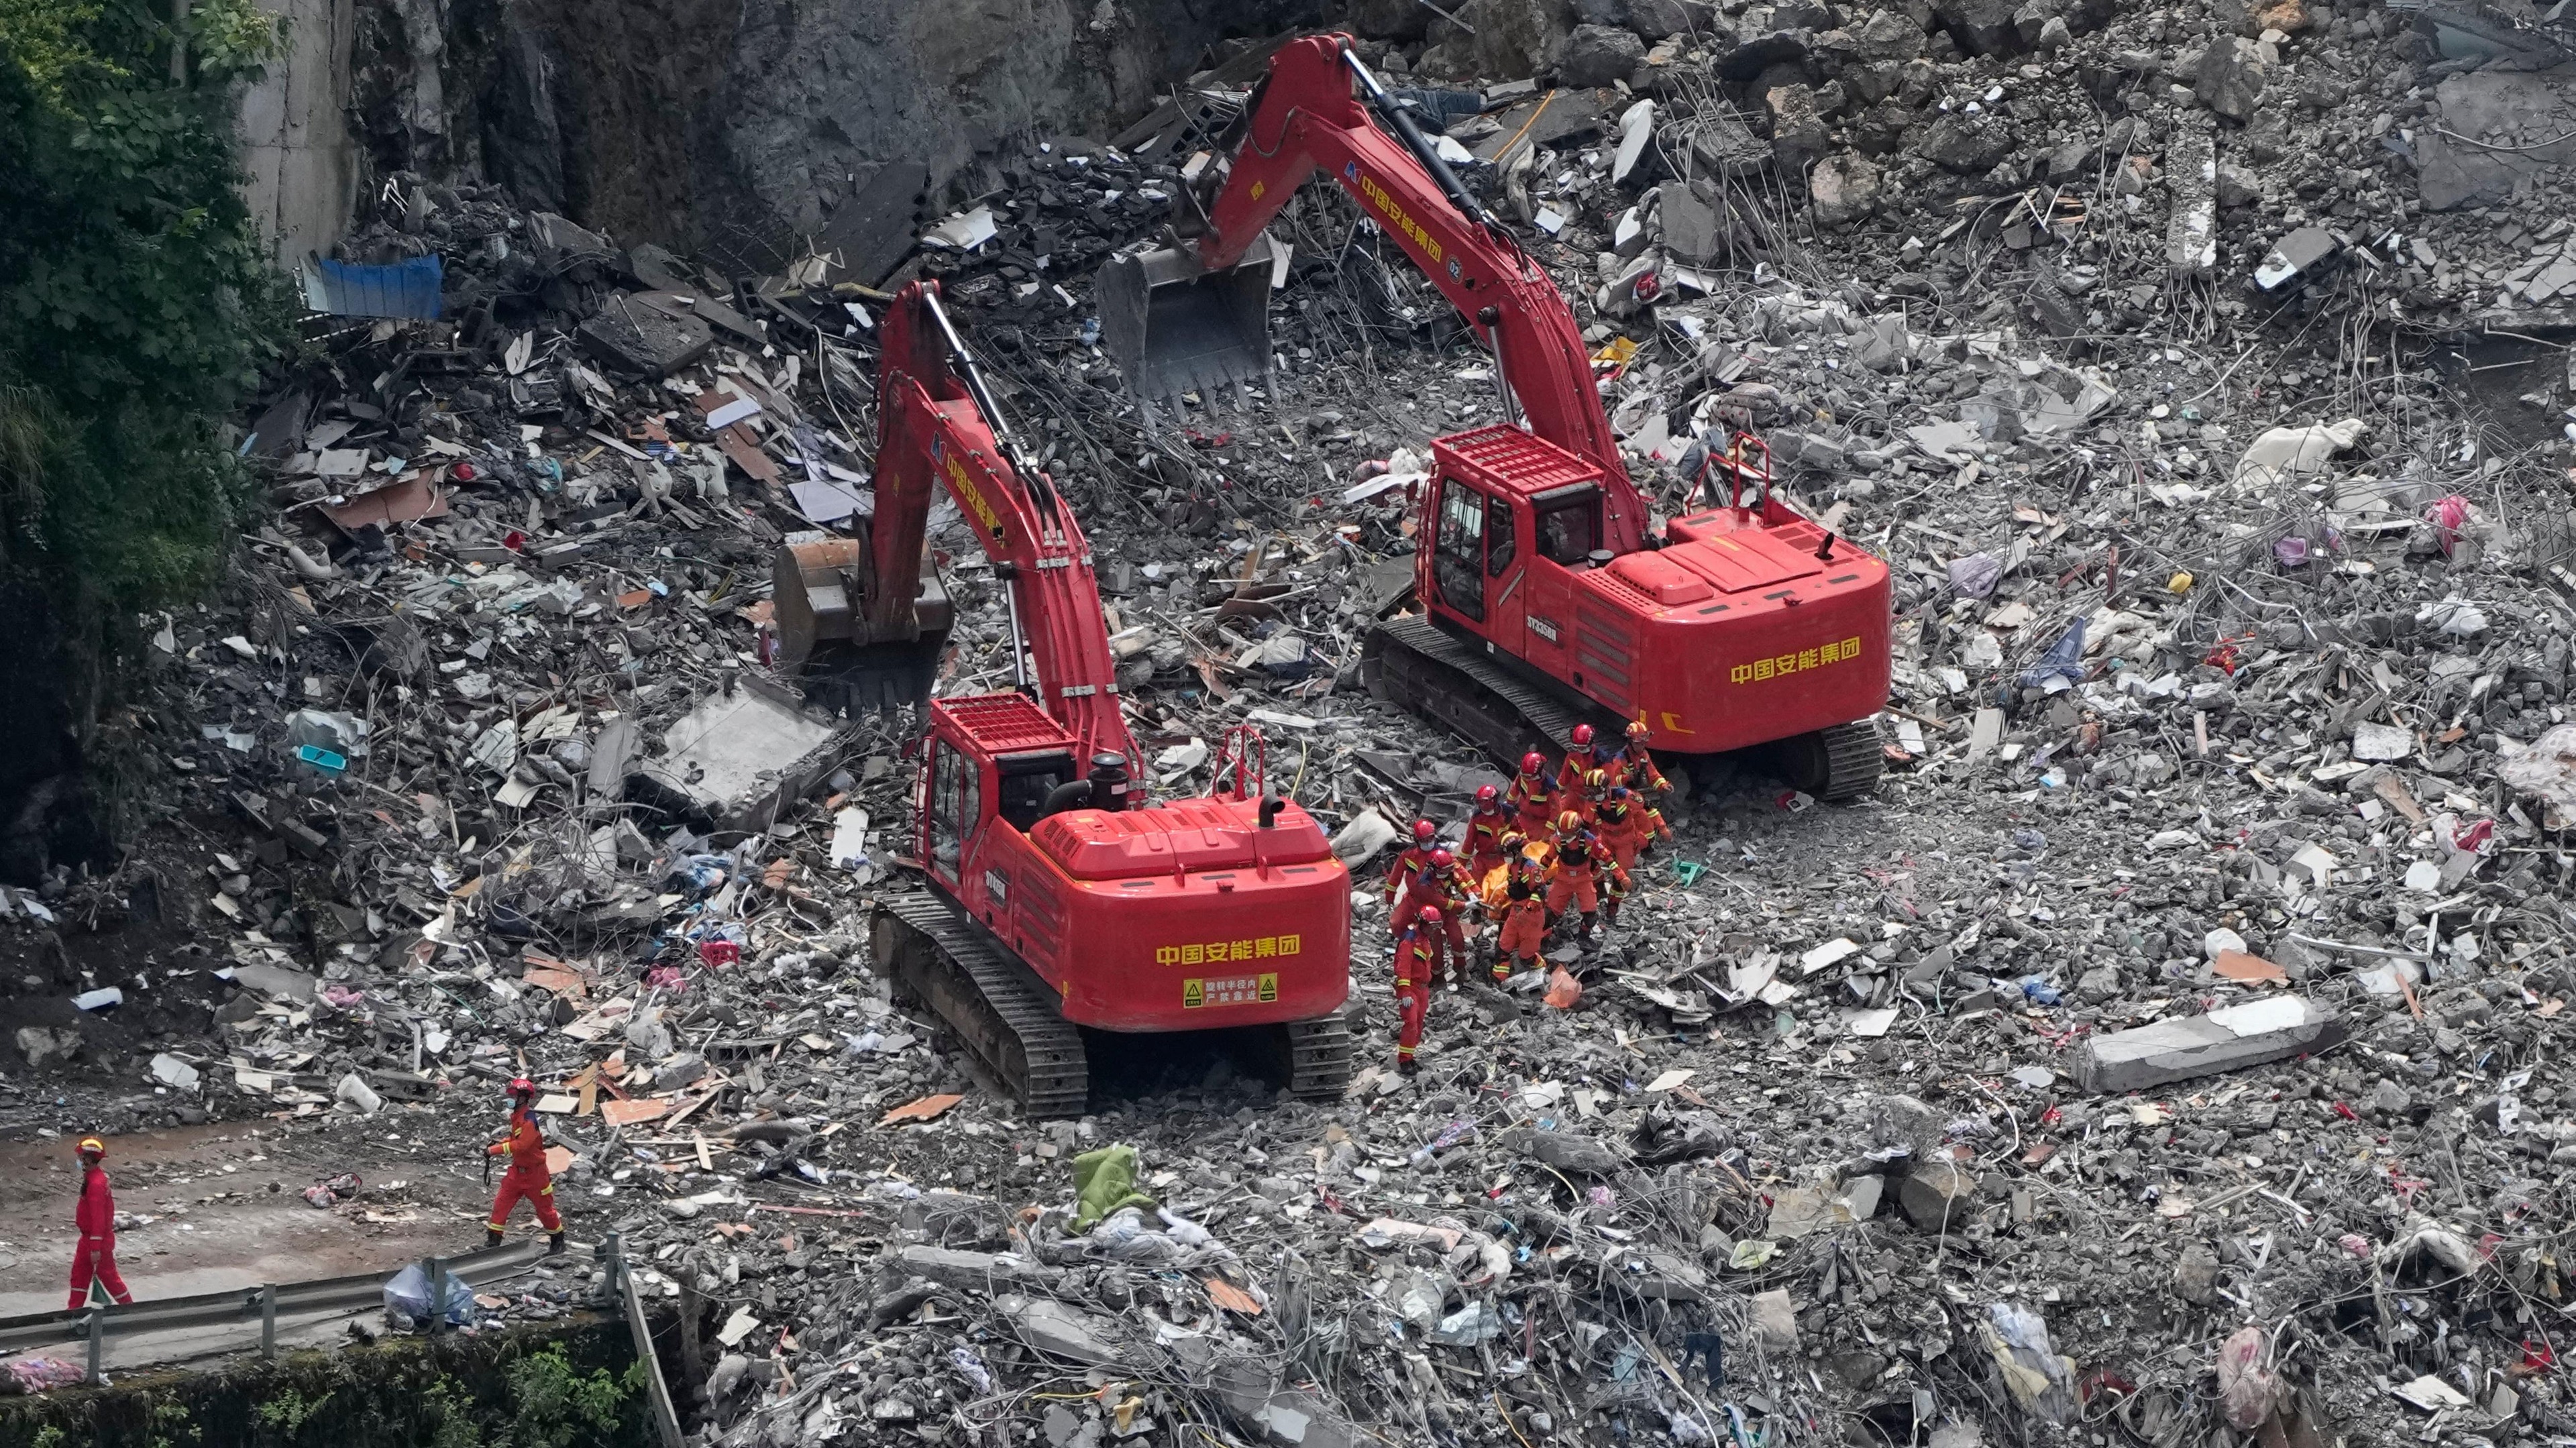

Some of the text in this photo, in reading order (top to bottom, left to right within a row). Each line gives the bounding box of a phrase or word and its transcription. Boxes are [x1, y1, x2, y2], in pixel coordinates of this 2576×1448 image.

[1362, 176, 1442, 263] 中国安能集团
[1450, 262, 1459, 278] 02
[1731, 636, 1860, 685] 中国安能集团
[1156, 934, 1301, 966] 中国安能集团
